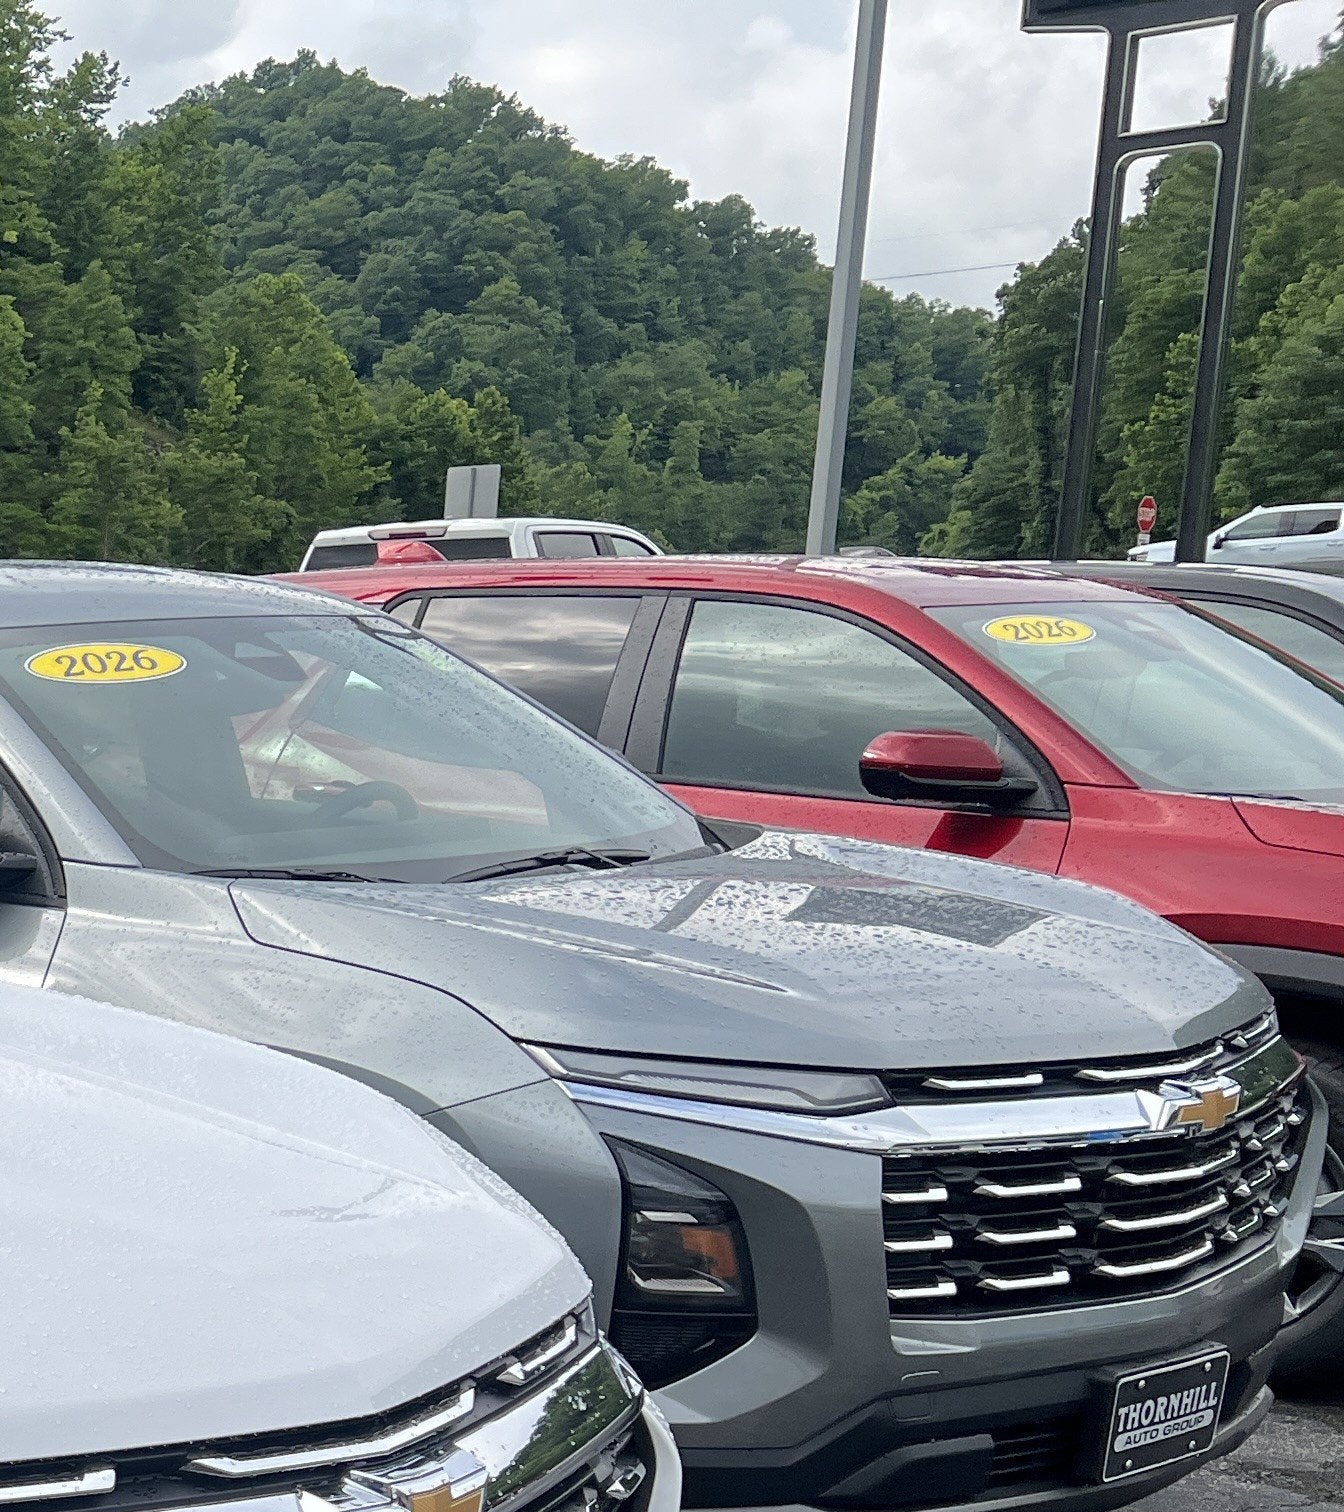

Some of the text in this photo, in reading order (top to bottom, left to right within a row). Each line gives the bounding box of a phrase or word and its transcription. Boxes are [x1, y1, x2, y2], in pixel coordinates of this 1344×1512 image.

[1002, 620, 1077, 641] 2026
[54, 649, 158, 677] 2026
[1117, 1381, 1218, 1433] THORNHILL
[1123, 1414, 1205, 1448] AUTO GROUP
